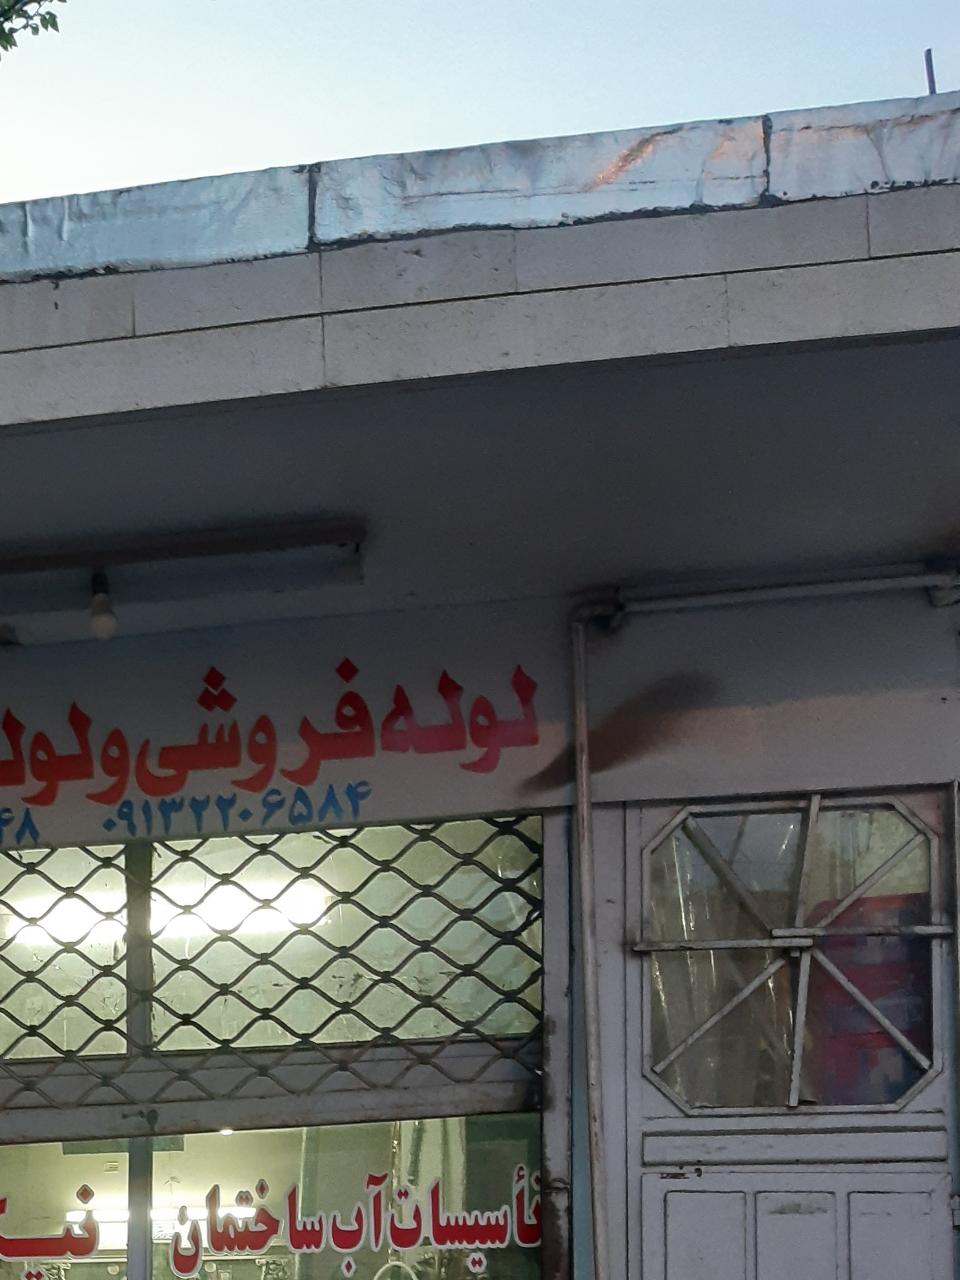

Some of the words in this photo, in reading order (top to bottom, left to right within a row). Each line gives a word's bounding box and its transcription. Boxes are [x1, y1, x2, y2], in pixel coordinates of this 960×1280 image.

[135, 656, 376, 798] فروشی
[381, 663, 540, 774] لوله
[101, 780, 373, 837] ۰۹۱۳۲۲۰۶۵۸۴
[169, 1178, 326, 1279] ساختمان
[329, 1172, 389, 1278] آب
